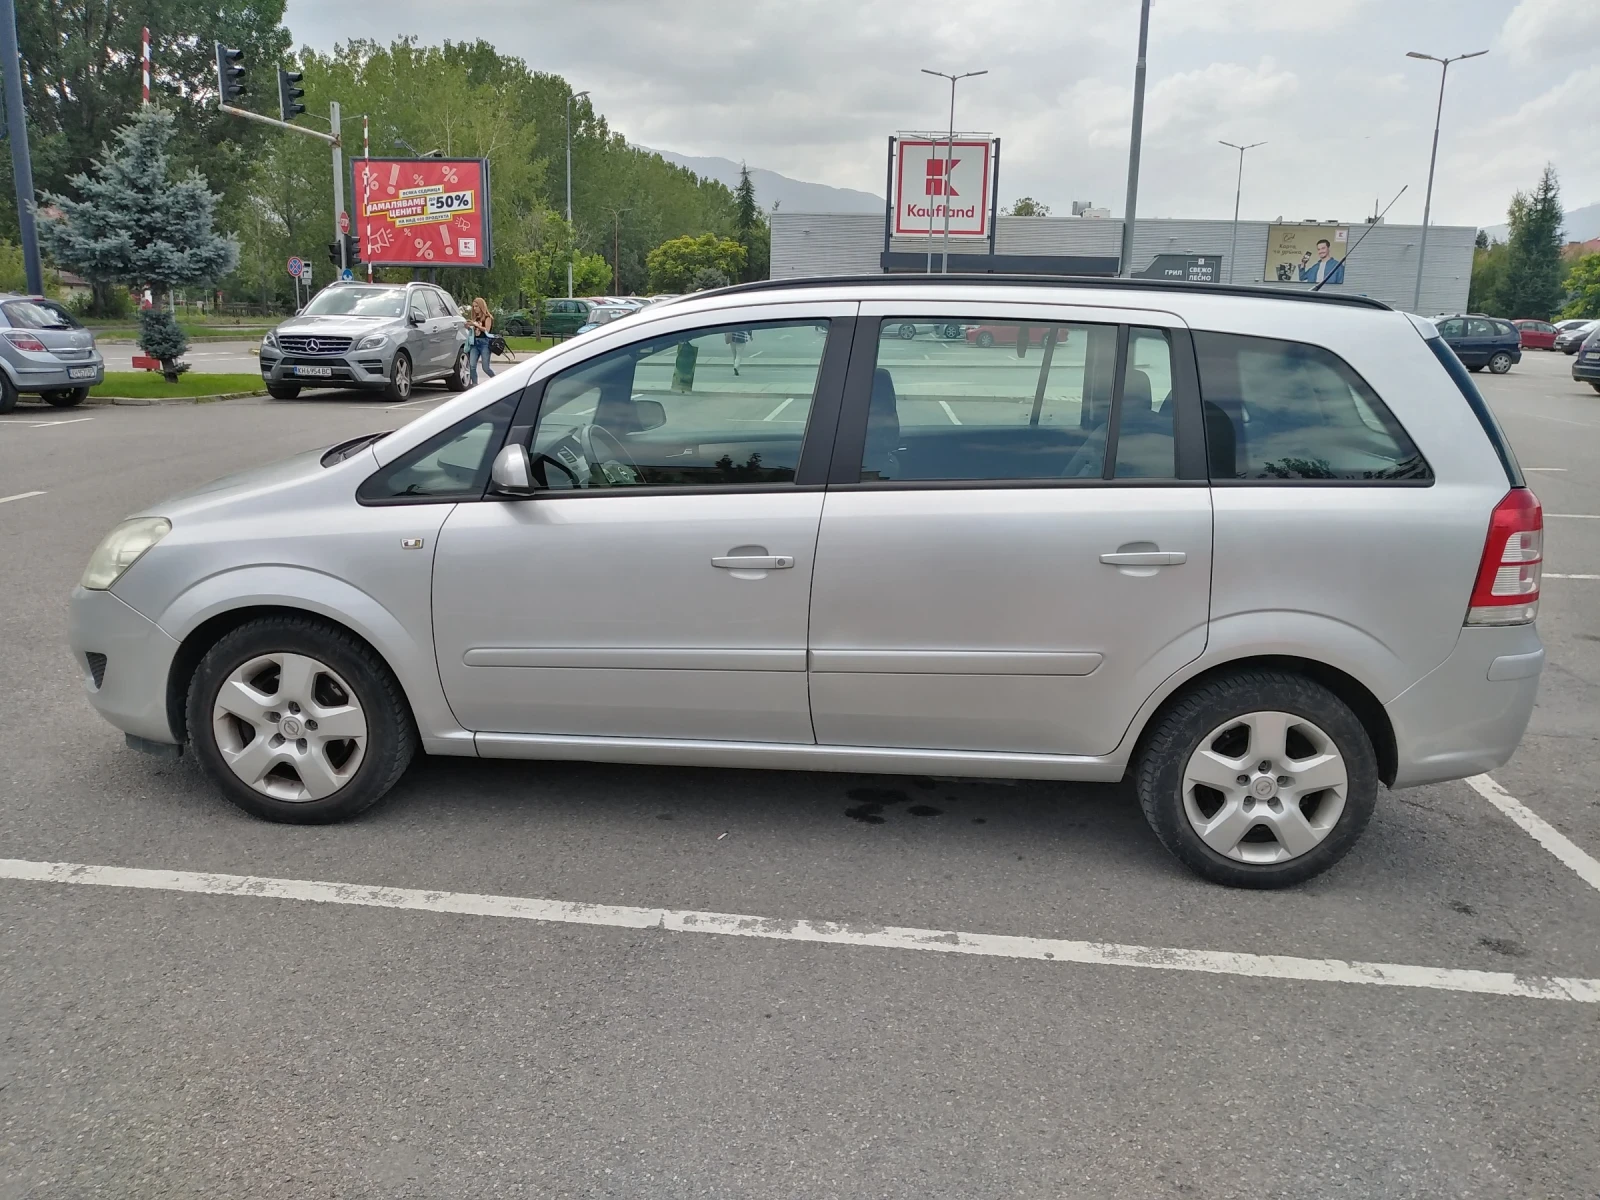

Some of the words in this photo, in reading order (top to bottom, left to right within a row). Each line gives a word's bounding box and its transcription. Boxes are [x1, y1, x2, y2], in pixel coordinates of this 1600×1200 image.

[430, 193, 469, 209] -50%
[389, 206, 422, 218] ЦЕНИТЕ
[907, 204, 975, 218] Kaufland
